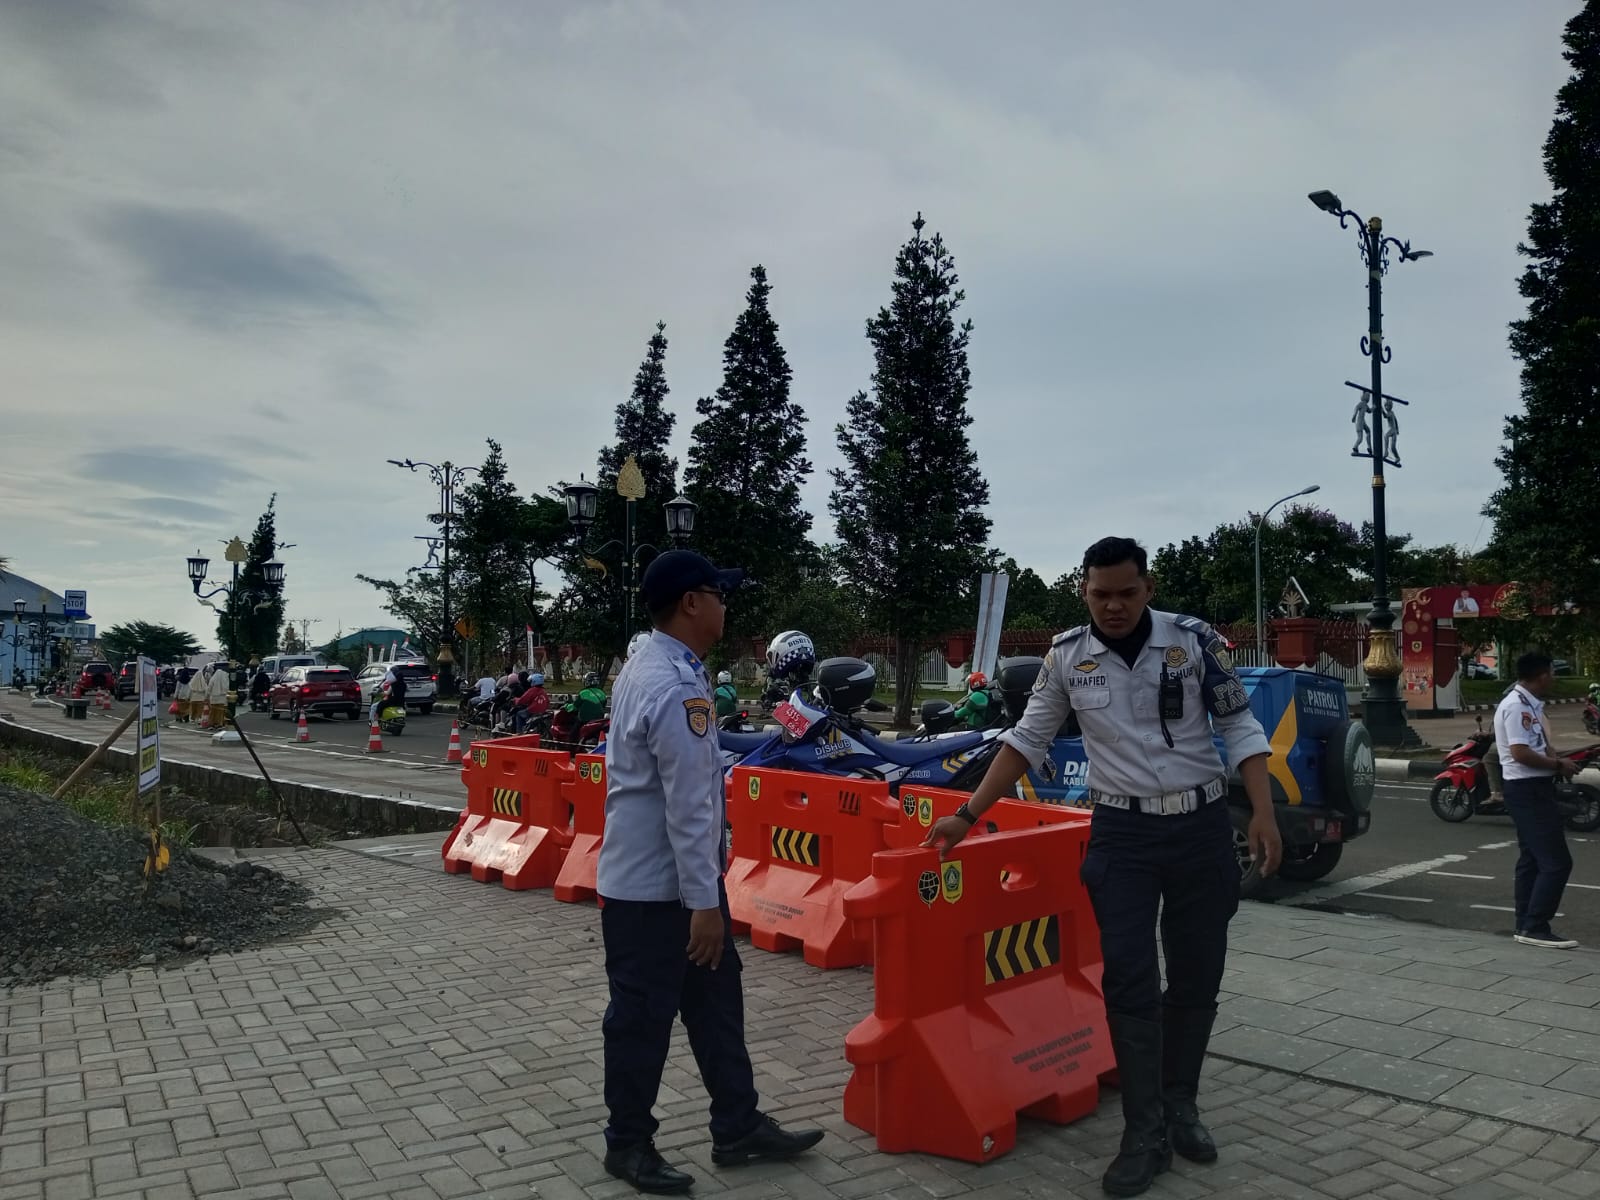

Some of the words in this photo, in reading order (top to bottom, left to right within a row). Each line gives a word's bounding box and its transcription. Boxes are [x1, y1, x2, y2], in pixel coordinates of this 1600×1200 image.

[67, 600, 84, 608] STOP
[1306, 689, 1339, 710] PATROLI
[815, 739, 852, 756] DISHUB
